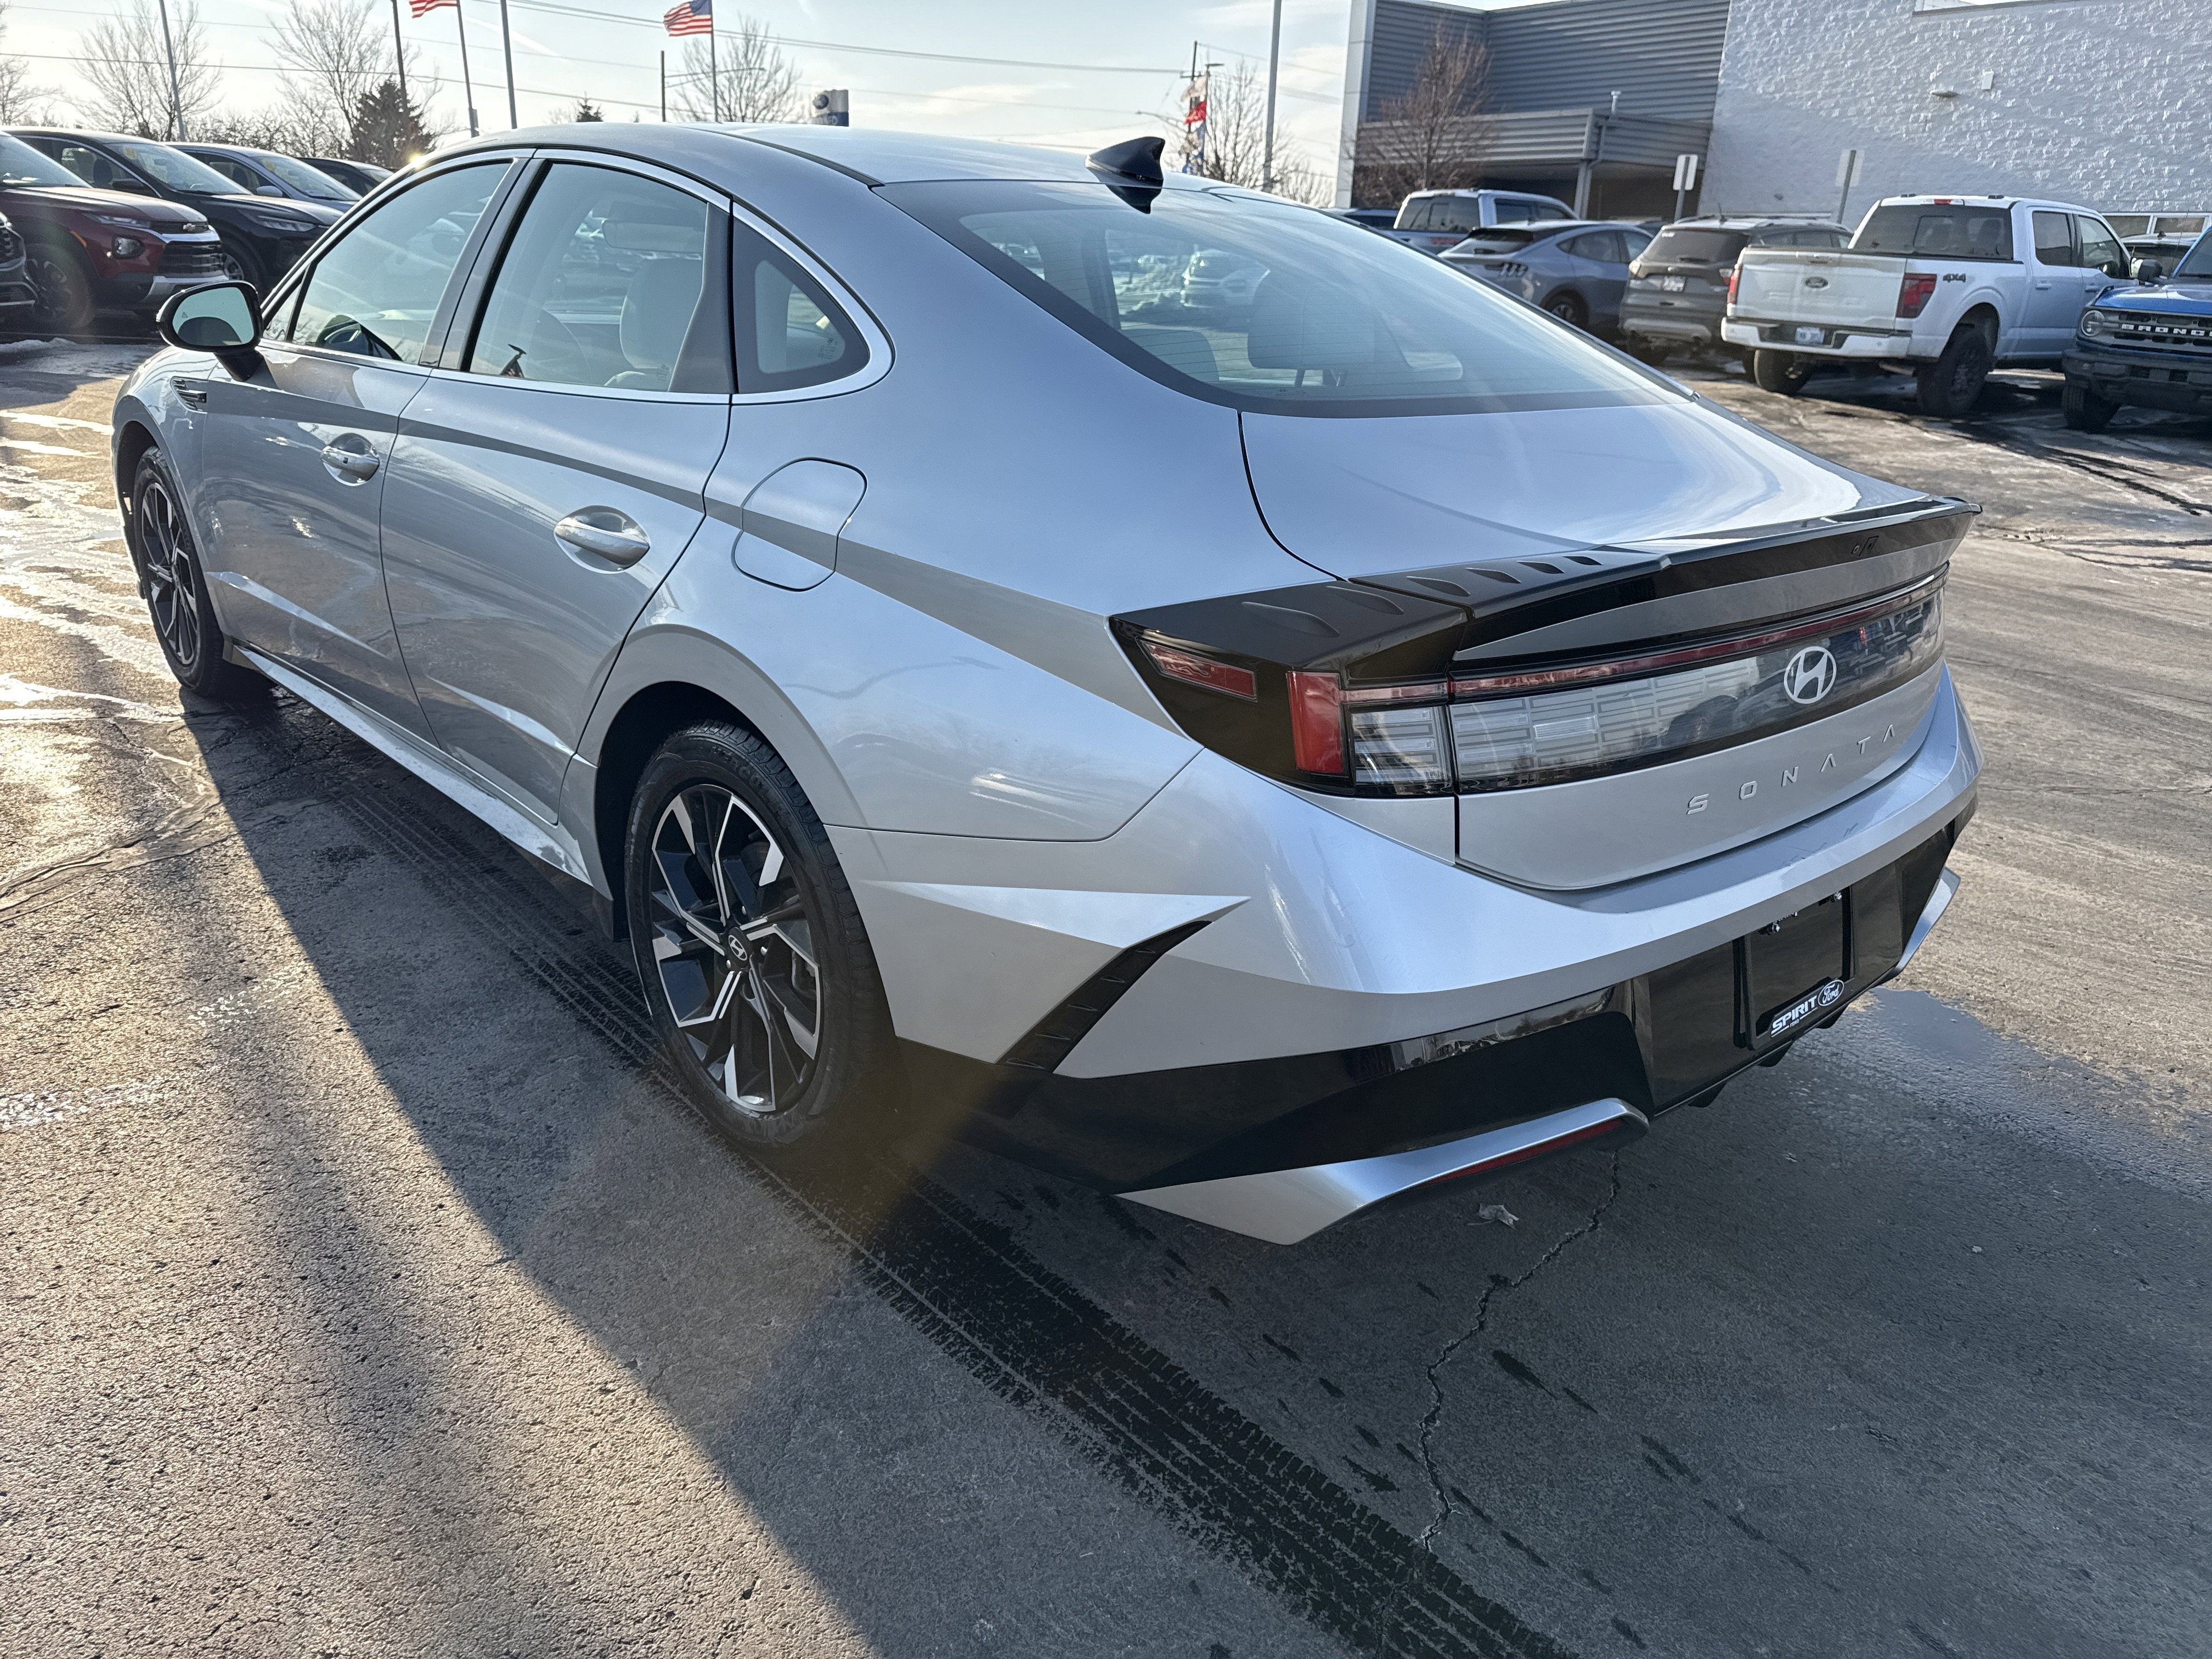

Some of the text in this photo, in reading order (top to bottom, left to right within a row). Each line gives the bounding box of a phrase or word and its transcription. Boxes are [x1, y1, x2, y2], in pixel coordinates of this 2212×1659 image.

[2121, 323, 2212, 336] BRONC
[1687, 724, 1895, 815] SONATA
[1771, 983, 1841, 1034] SPIRIT Ford
